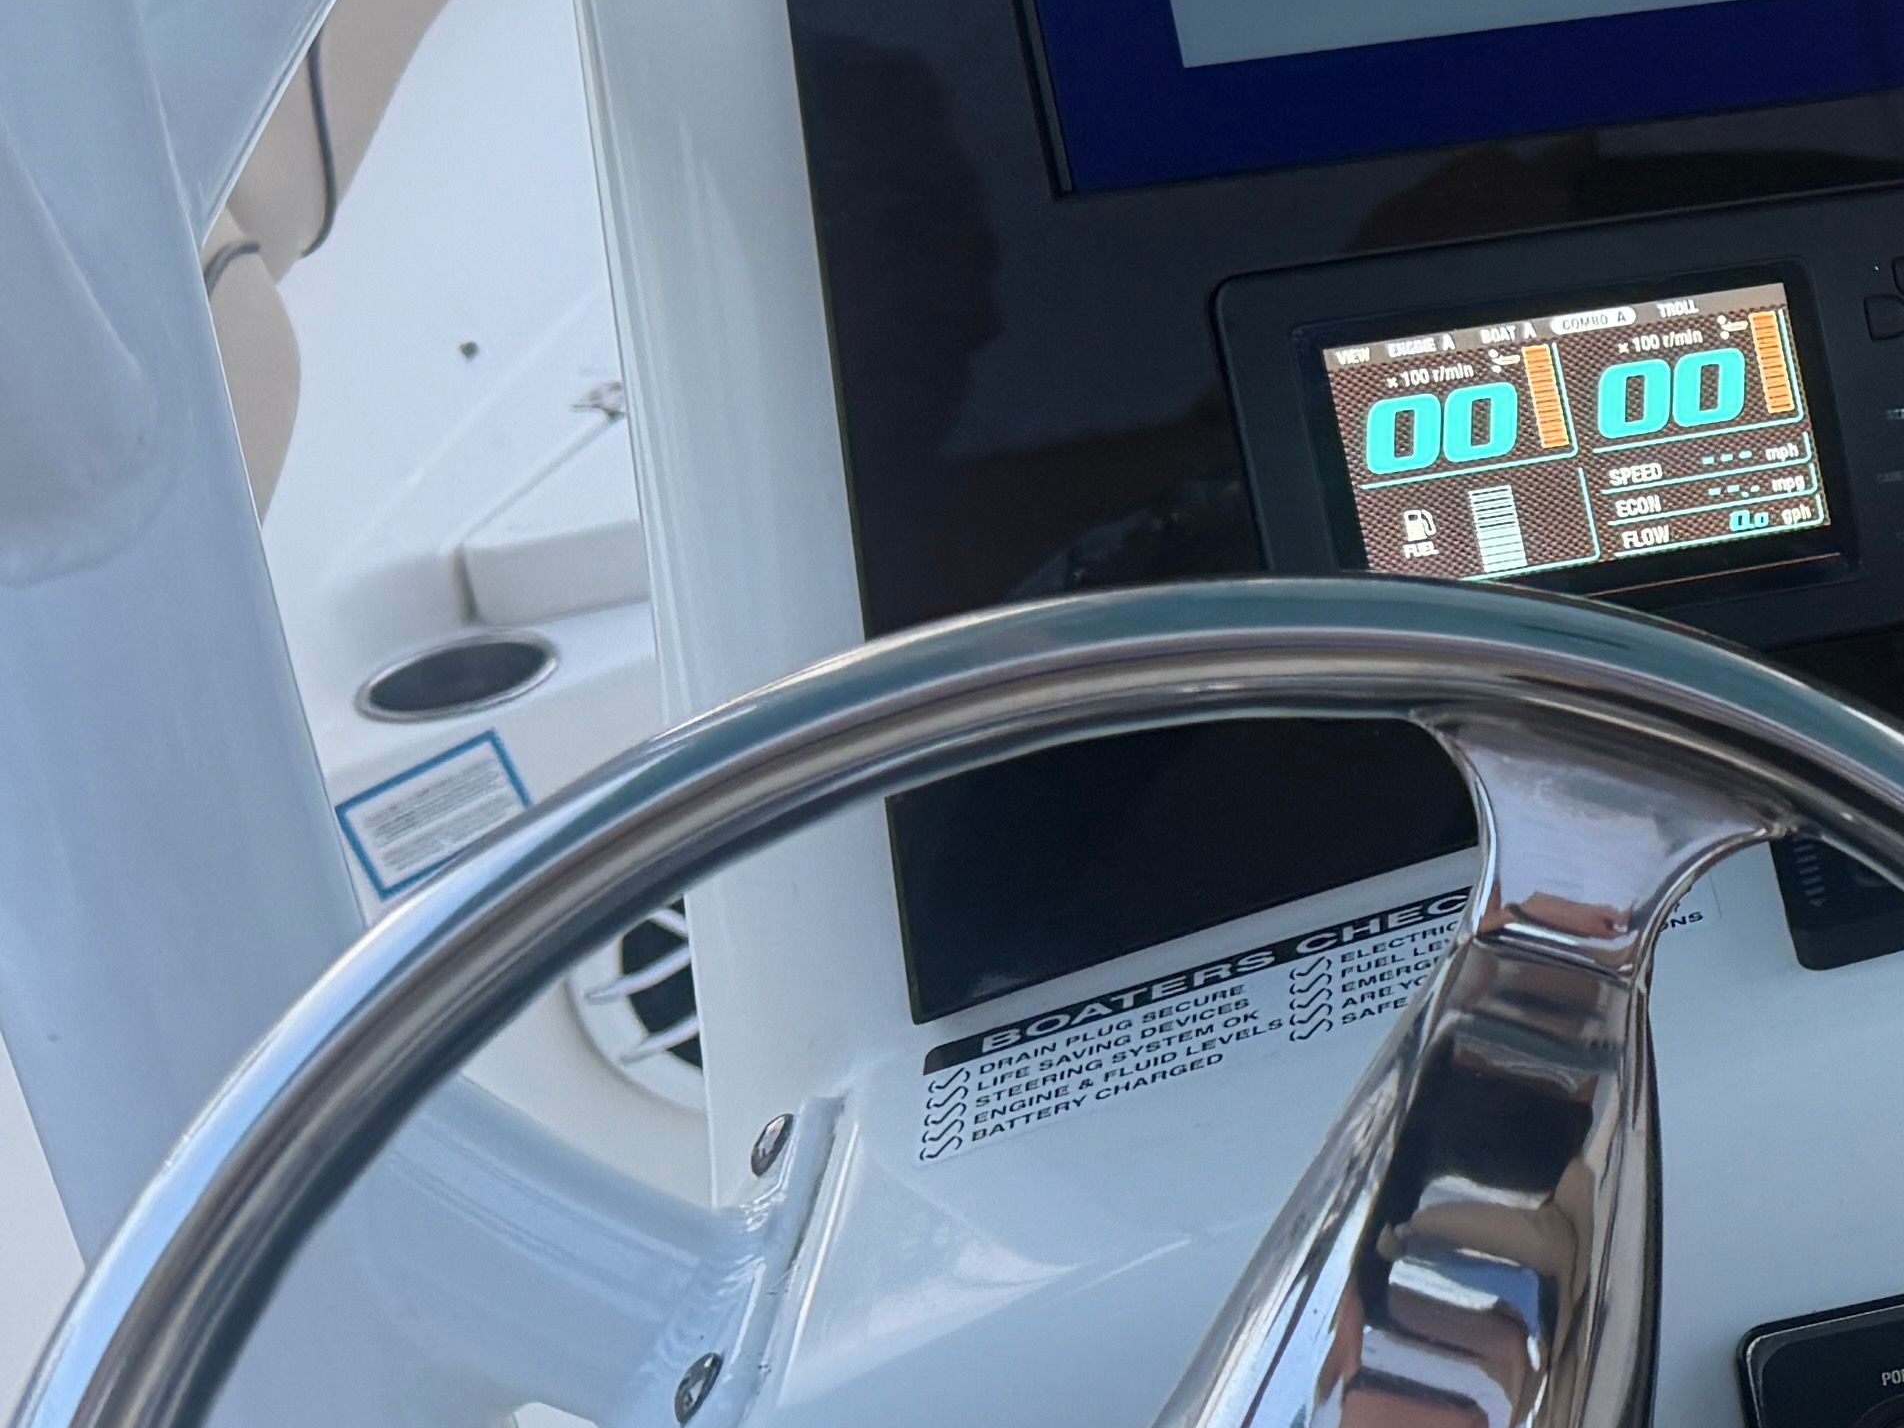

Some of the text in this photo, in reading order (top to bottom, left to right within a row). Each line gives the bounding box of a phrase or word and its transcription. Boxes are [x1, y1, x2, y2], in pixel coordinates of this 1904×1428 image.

[1336, 347, 1370, 365] VIEW
[1480, 325, 1516, 343] BOAT
[1562, 314, 1608, 331] COMBO
[1658, 299, 1699, 318] TROLL
[1633, 328, 1702, 352] 100 r/min
[1399, 361, 1473, 386] 100 r/min
[1597, 347, 1746, 440] 00
[1366, 381, 1518, 475] 00
[1608, 443, 1799, 486] SPEED mph
[1615, 475, 1806, 517] ECON mpg
[1403, 541, 1438, 557] FUEL
[1621, 525, 1671, 547] FLOW
[982, 890, 1466, 1053] BOATERS CHEC
[1341, 952, 1401, 981] FUEL
[1342, 995, 1407, 1025] SAFE
[1343, 986, 1390, 1009] ARE
[977, 997, 1249, 1092] LIFE SAVING DEVICES
[980, 982, 1246, 1076] DRAIN PLUG SECURE
[974, 1084, 1069, 1123] ENGINE
[1105, 1050, 1176, 1081] FLUID
[1186, 1017, 1281, 1056] LEVELS
[976, 1009, 1260, 1107] STEERING SYSTEM OK
[972, 1052, 1221, 1140] BATTERY CHARGED
